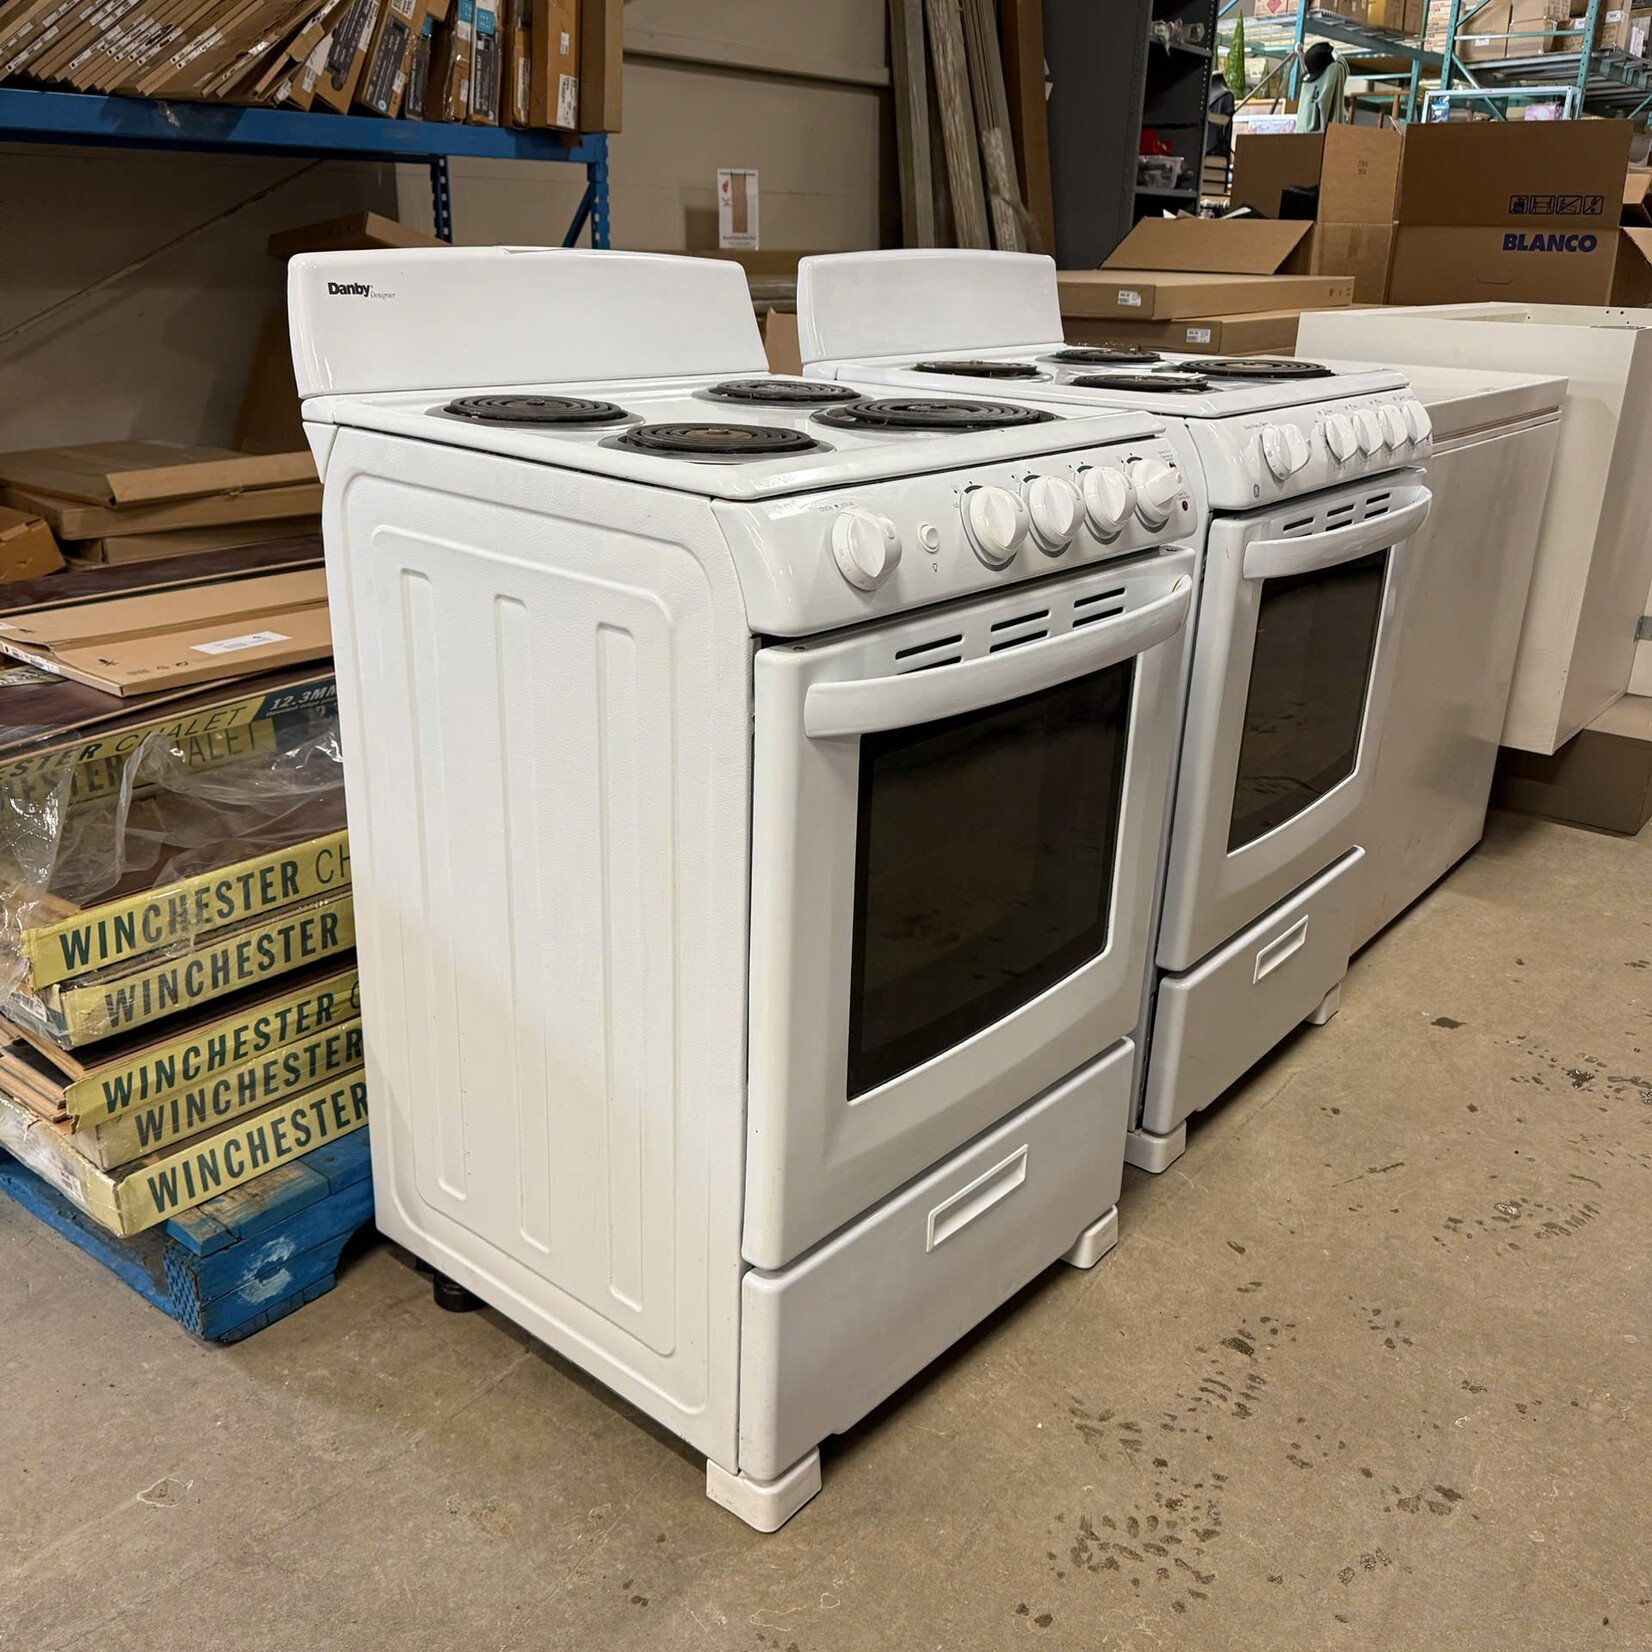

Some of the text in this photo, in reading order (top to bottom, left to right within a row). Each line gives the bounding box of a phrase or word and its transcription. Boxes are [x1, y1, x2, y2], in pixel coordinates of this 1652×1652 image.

[327, 282, 371, 298] Danby
[1502, 233, 1598, 253] BLANCO
[59, 860, 300, 971] WINCHESTER
[104, 911, 339, 1028] WINCHESTER
[102, 992, 335, 1114] WINCHESTER
[135, 1027, 363, 1148] WINCHESTER
[147, 1081, 368, 1213] WINCHESTER
